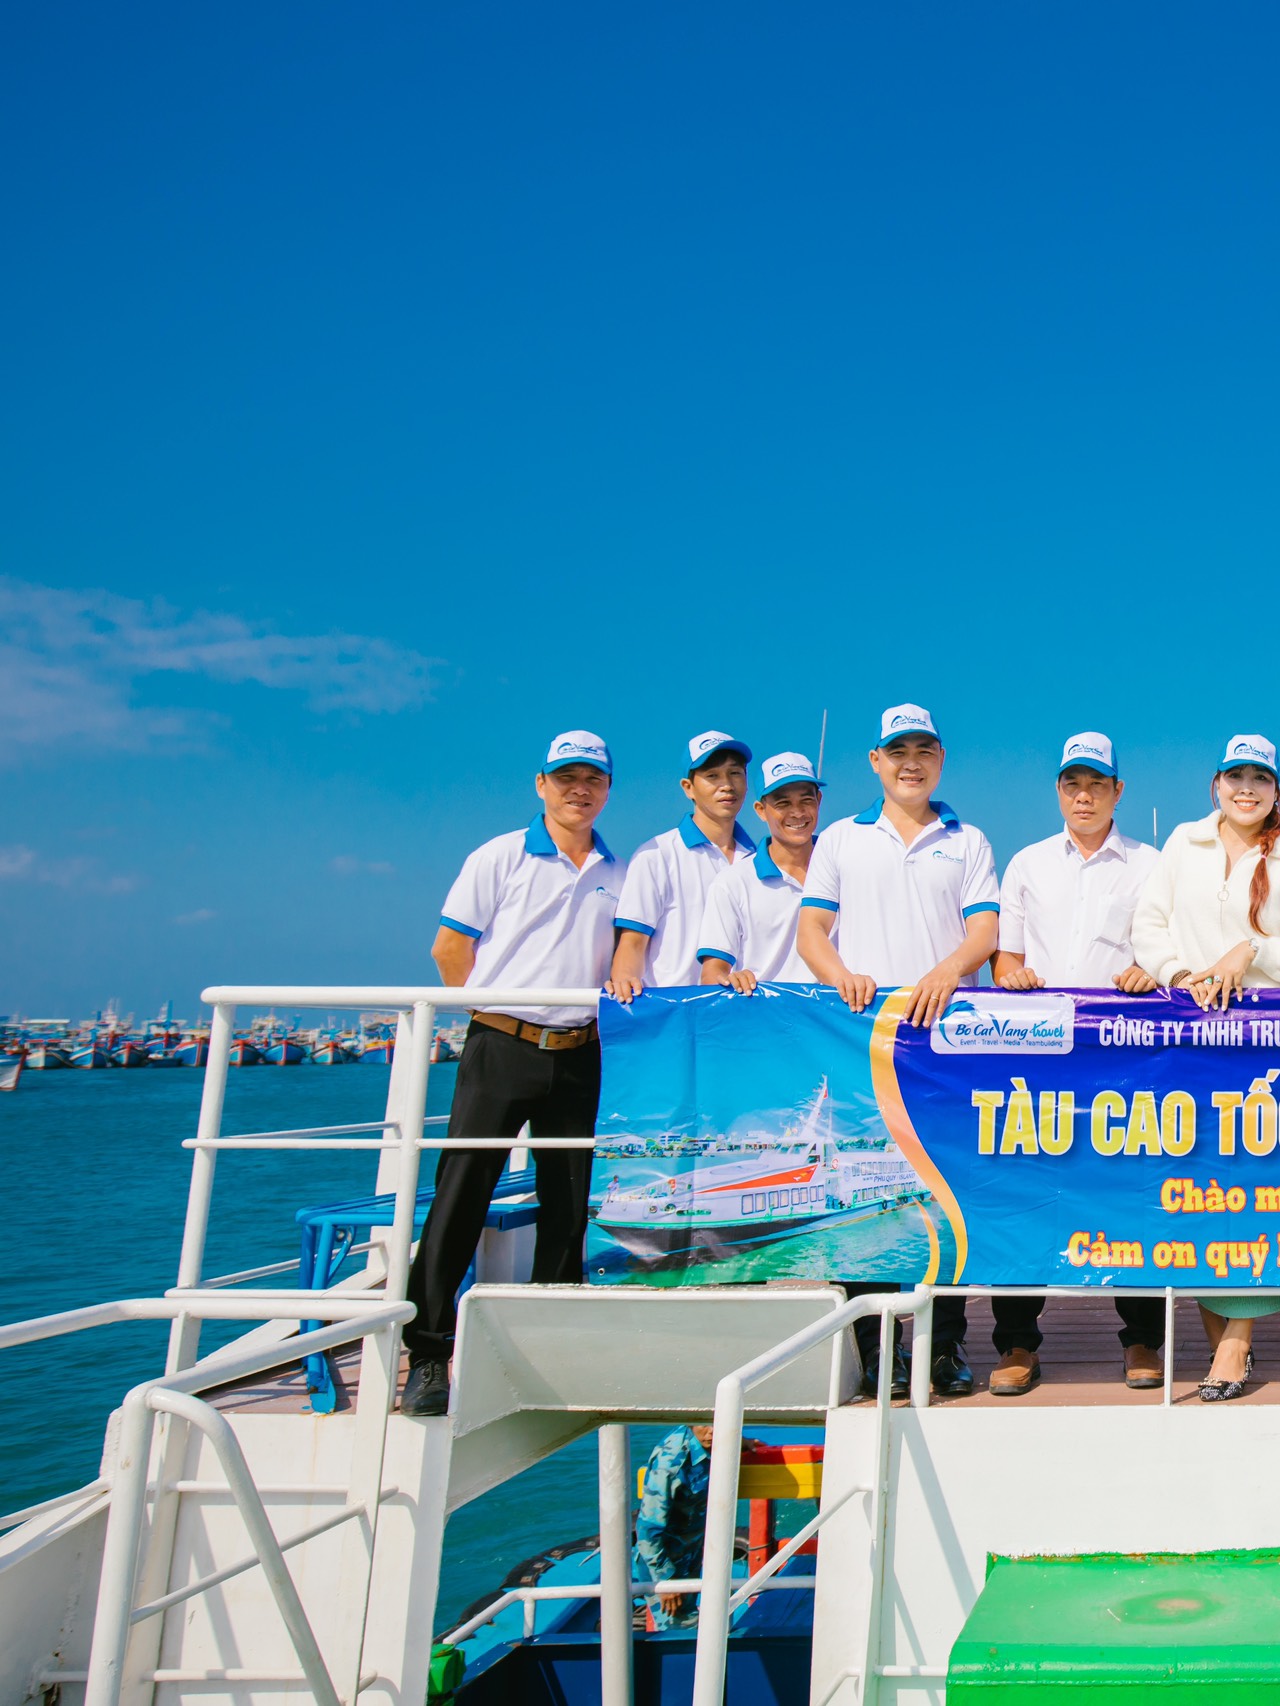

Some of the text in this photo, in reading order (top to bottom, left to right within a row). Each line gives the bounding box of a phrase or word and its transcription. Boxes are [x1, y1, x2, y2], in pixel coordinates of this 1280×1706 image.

[955, 1013, 1065, 1040] Bo Cat Vang travel
[1099, 1014, 1154, 1046] CÔNG
[1161, 1021, 1185, 1046] TY
[1190, 1021, 1243, 1046] TNHH
[1026, 1039, 1063, 1048] Teambuilding
[971, 1077, 1075, 1156] TÀU
[1090, 1089, 1196, 1157] CAO
[1160, 1178, 1247, 1213] Chào
[1067, 1230, 1144, 1268] Cảm
[1205, 1233, 1270, 1278] quý
